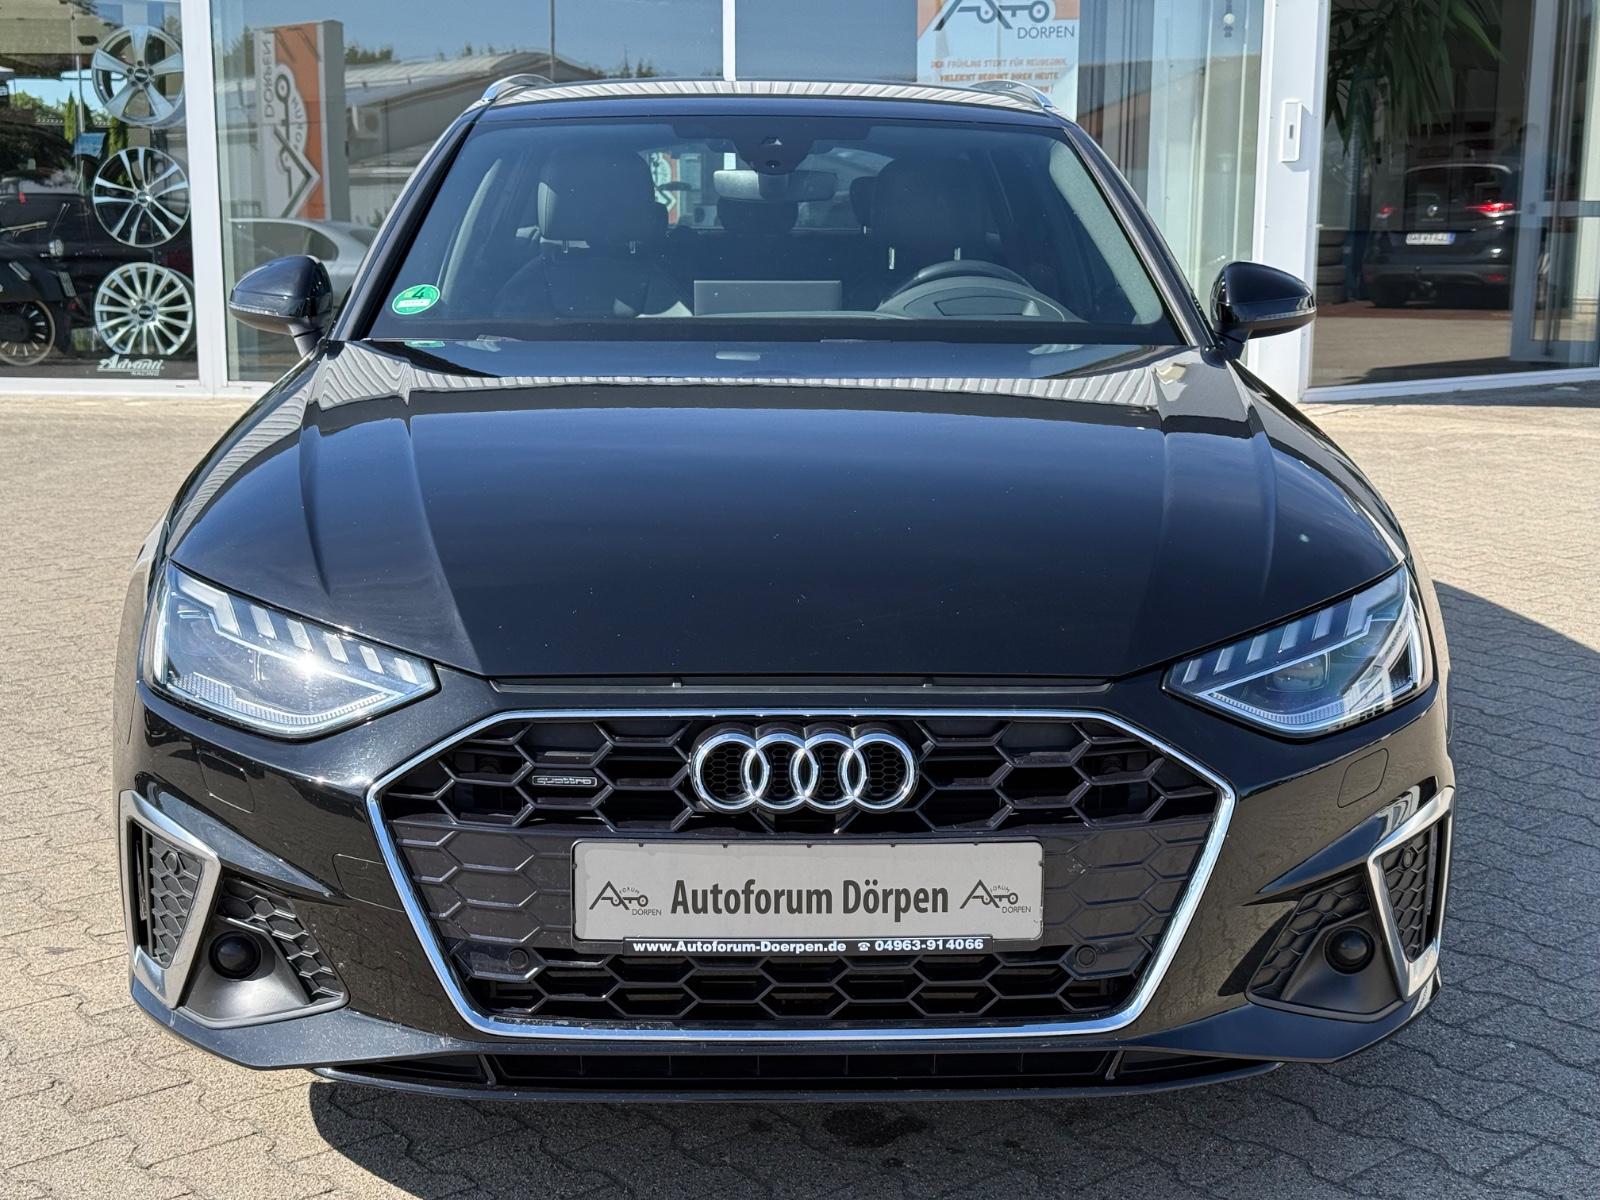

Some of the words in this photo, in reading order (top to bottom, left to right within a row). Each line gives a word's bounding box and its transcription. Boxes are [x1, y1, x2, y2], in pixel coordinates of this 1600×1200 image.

[537, 777, 592, 785] quattro
[671, 879, 833, 915] Autoforum
[842, 879, 949, 922] Dörpen
[633, 940, 847, 954] www.Autoforum-Doerpen.de
[874, 938, 985, 952] 04963-914066
